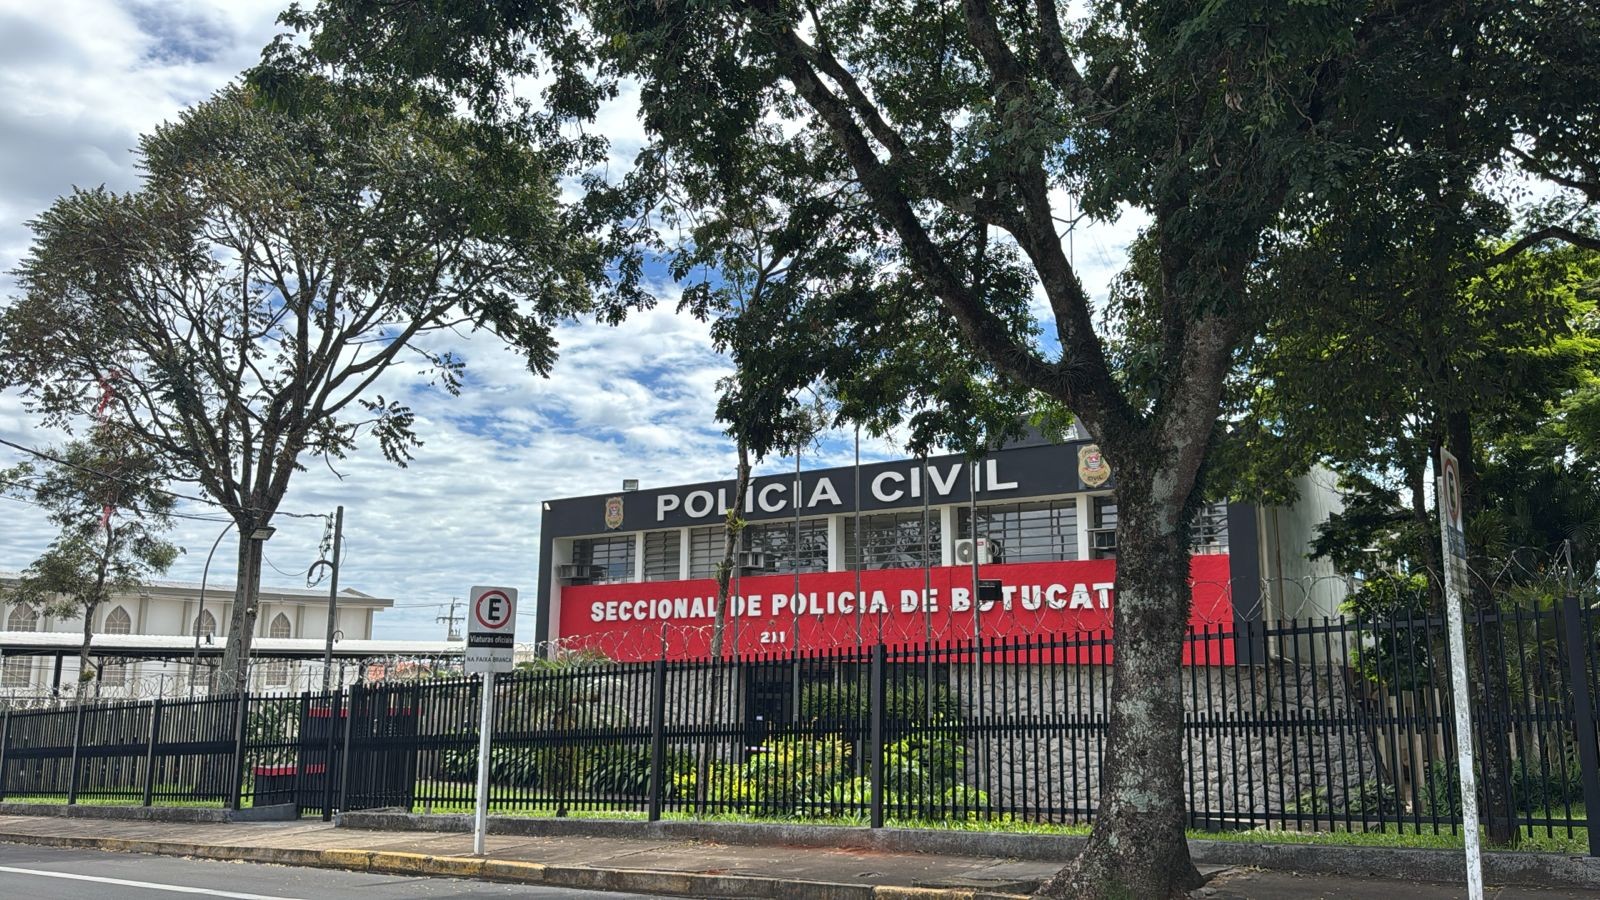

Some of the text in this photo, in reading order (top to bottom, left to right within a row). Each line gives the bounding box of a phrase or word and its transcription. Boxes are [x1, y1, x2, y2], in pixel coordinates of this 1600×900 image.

[656, 459, 1019, 522] POLÍCIA CIVIL
[488, 598, 502, 620] E
[590, 597, 719, 622] SECCIONAL
[730, 594, 762, 617] DE
[772, 590, 889, 616] POLICIA
[900, 588, 939, 613] DE
[470, 634, 494, 643] Viaturas
[760, 631, 786, 644] 211
